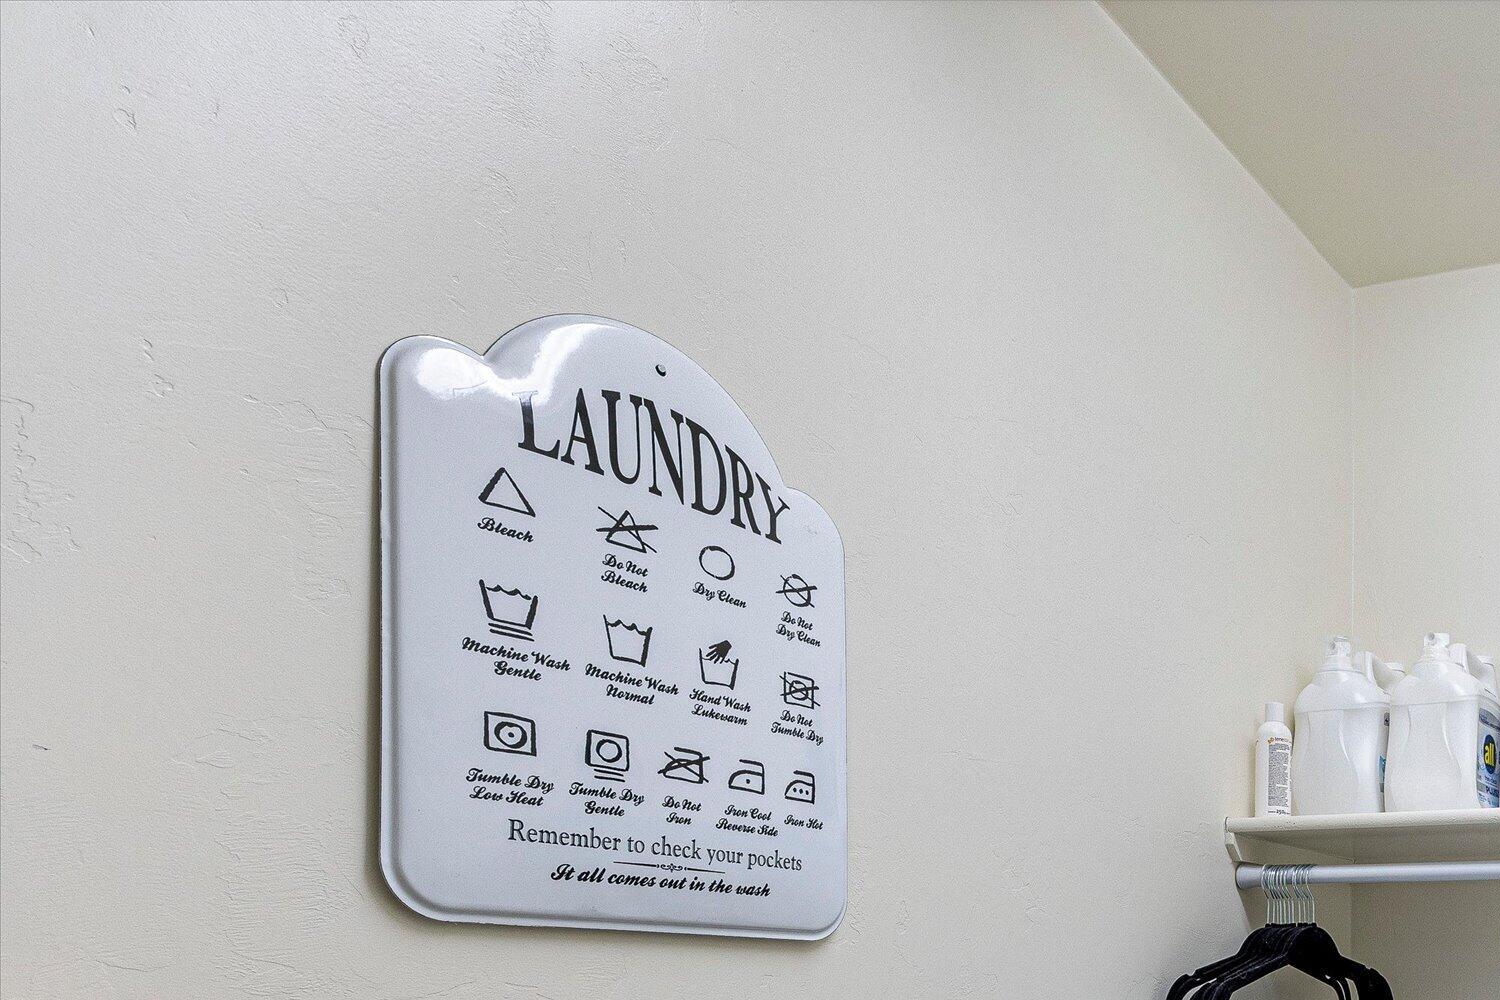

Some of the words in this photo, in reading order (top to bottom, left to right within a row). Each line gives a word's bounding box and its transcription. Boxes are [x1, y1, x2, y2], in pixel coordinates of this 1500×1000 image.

[512, 388, 790, 544] LAUNDRY
[477, 517, 533, 542] Bleach
[602, 554, 624, 569] Do
[626, 561, 648, 577] Not
[601, 570, 648, 593] Bleach
[693, 582, 715, 601] Dry
[717, 590, 746, 608] Clean
[781, 611, 796, 624] Do
[797, 617, 813, 631] Not
[776, 624, 795, 641] Dry
[797, 631, 821, 647] Clean
[462, 637, 528, 662] Machine
[531, 651, 570, 671] Wash
[494, 661, 542, 681] Gentle
[585, 664, 642, 687] Machine
[645, 677, 679, 695] Wash
[606, 684, 654, 704] Normal
[689, 689, 722, 705] Hand
[723, 696, 751, 712] Wash
[692, 704, 748, 726] Lukewarm
[780, 710, 795, 722] Do
[796, 714, 813, 727] Not
[771, 722, 804, 739] Tumble
[806, 730, 824, 746] Dry
[1485, 743, 1494, 766] all
[466, 768, 522, 786] Tumble
[524, 776, 554, 794] Dry
[470, 786, 503, 801] Low
[506, 790, 544, 806] Heat
[569, 782, 616, 800] Tumble
[619, 789, 645, 806] Dry
[662, 796, 680, 808] Do
[682, 799, 701, 812] Not
[585, 801, 625, 817] Gentle
[666, 812, 692, 825] Iron
[725, 805, 749, 817] Iron
[749, 808, 772, 821] Cool
[716, 818, 756, 834] Reverse
[757, 825, 778, 836] Side
[784, 815, 805, 827] Iron
[806, 818, 823, 830] Hot
[508, 819, 621, 851] Remember
[627, 837, 645, 854] to
[651, 836, 701, 859] check
[707, 848, 743, 864] your
[748, 852, 802, 871] pockets
[551, 864, 575, 881] It
[577, 868, 604, 882] all
[607, 873, 656, 887] comes
[659, 877, 687, 890] out
[690, 878, 705, 892] in
[708, 880, 733, 894] the
[735, 883, 771, 897] wash
